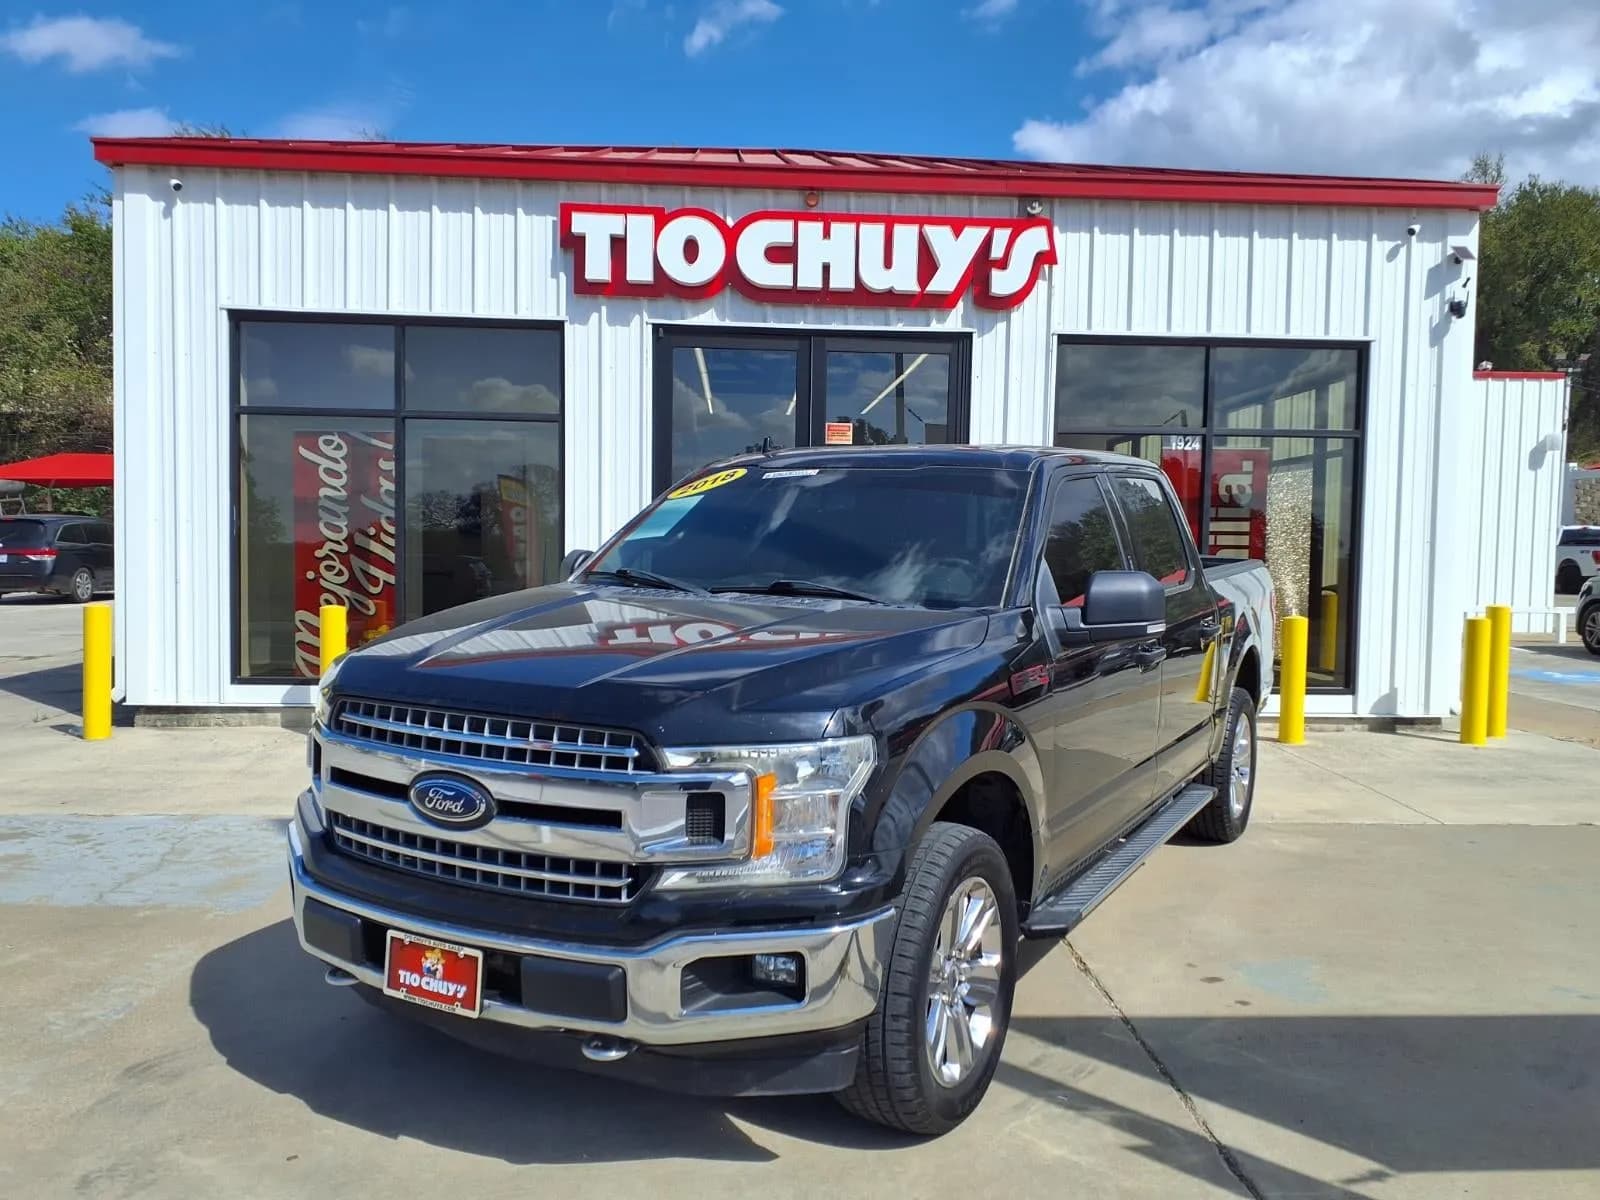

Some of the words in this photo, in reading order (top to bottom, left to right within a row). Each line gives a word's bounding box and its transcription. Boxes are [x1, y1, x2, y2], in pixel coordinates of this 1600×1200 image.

[571, 212, 726, 287] TIO
[736, 218, 1051, 298] CHUY'S
[1171, 435, 1200, 450] 1924
[676, 470, 739, 496] 2018
[425, 787, 465, 813] Ford
[398, 969, 420, 987] TIO
[421, 977, 467, 998] CHUY'S
